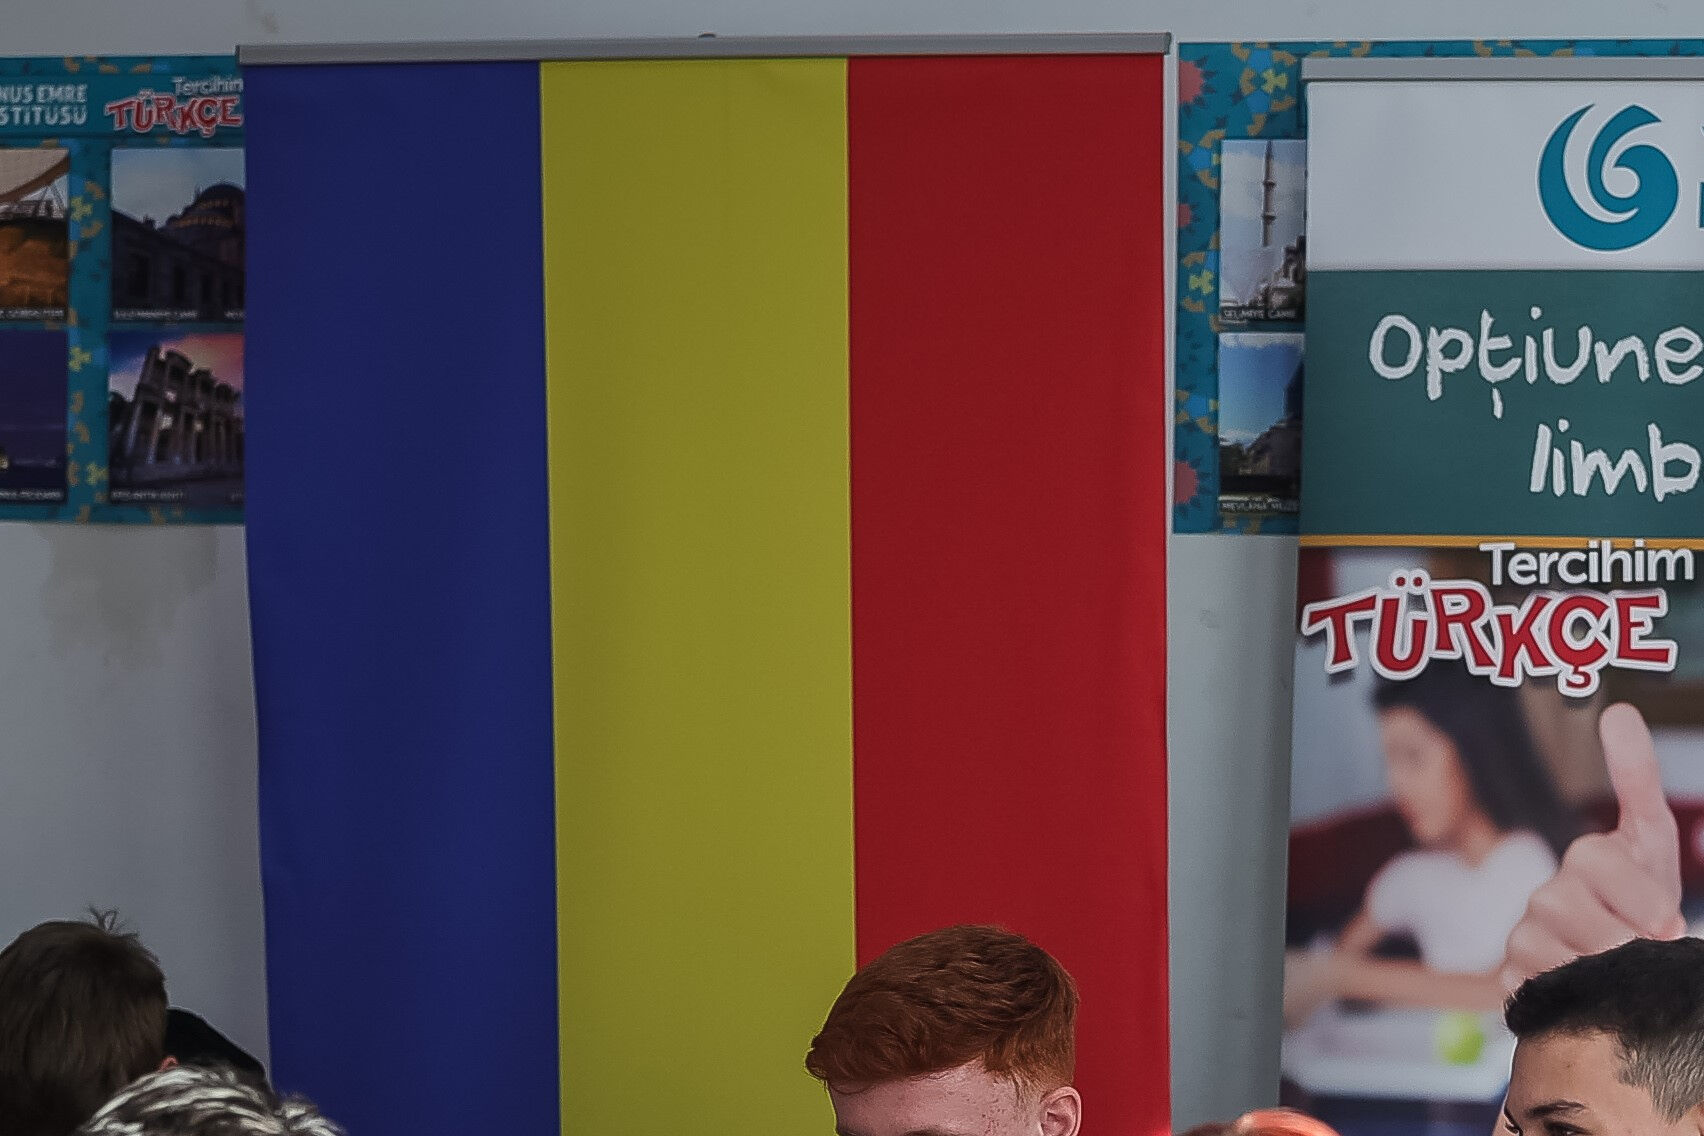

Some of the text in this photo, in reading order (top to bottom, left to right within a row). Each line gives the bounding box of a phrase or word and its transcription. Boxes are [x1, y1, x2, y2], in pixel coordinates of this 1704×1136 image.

[37, 84, 88, 103] EMRE
[105, 89, 244, 138] TÜRKÇE
[1479, 539, 1694, 585] Tercihim
[1302, 568, 1678, 698] TÜRKÇE
